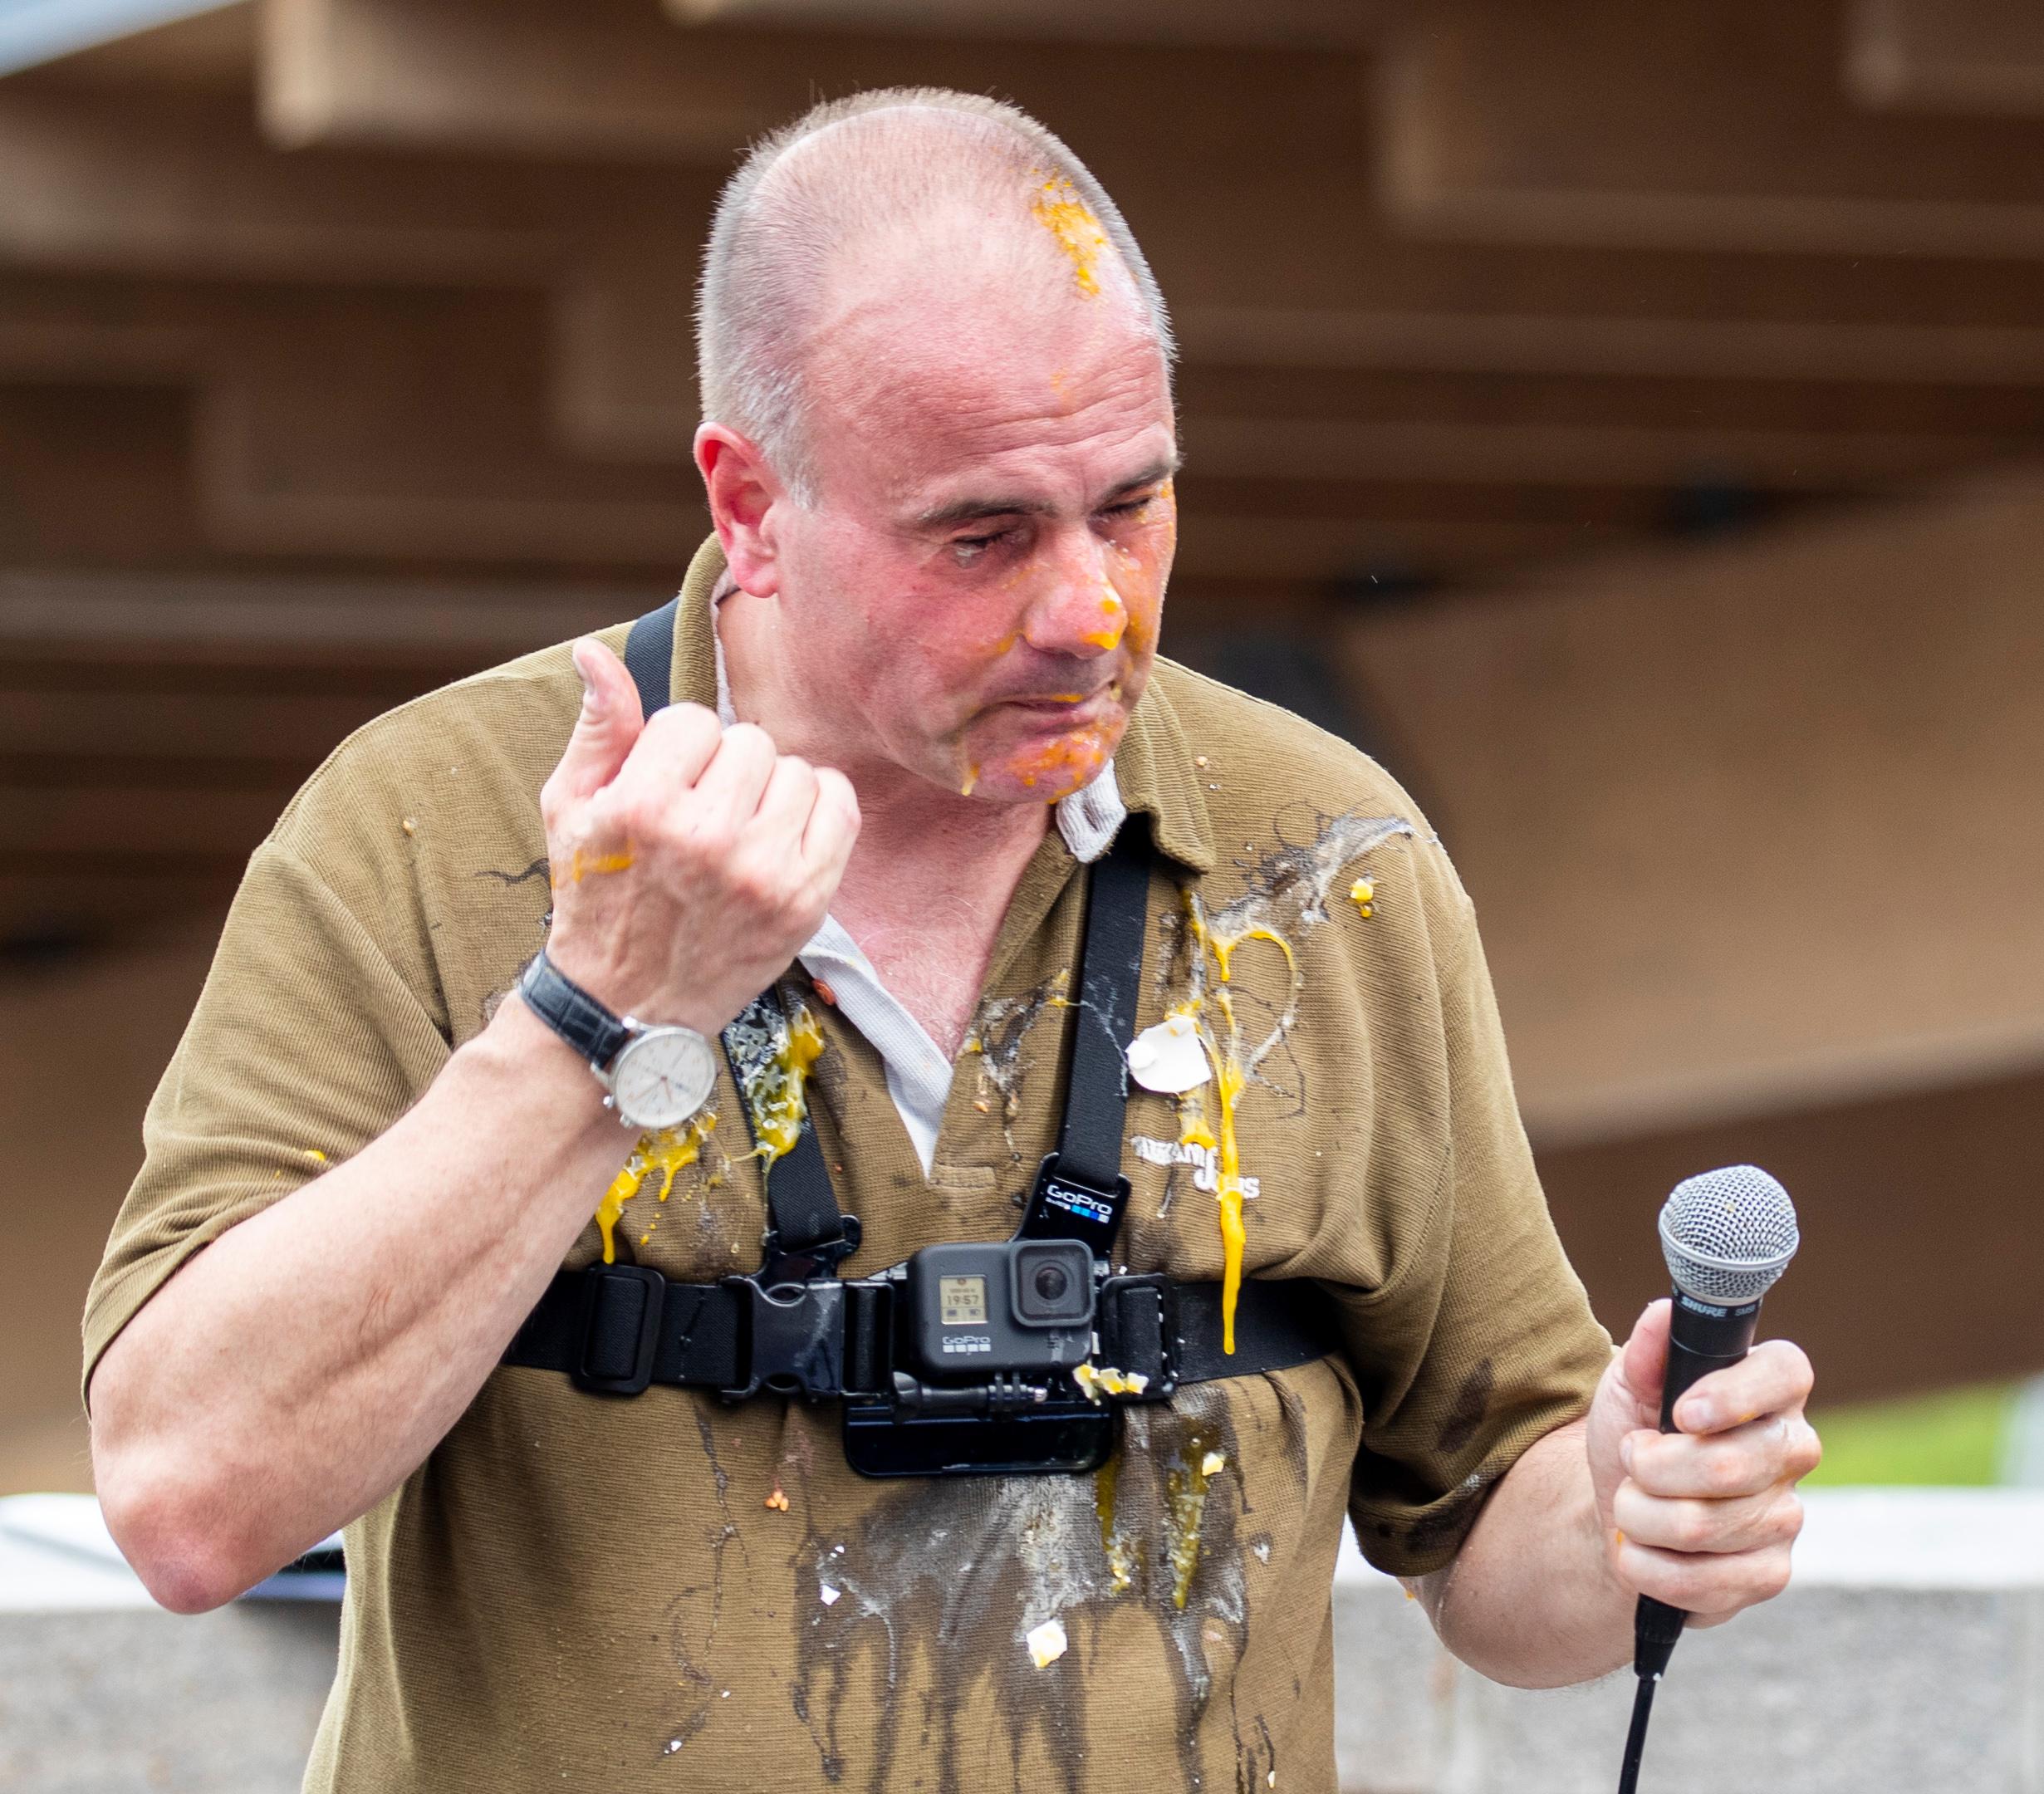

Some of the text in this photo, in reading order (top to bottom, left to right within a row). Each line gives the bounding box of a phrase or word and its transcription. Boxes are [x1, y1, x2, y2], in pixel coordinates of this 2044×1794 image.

[1047, 1184, 1113, 1215] GoPro
[1680, 1296, 1728, 1317] SHURE
[942, 1336, 991, 1345] GoPro
